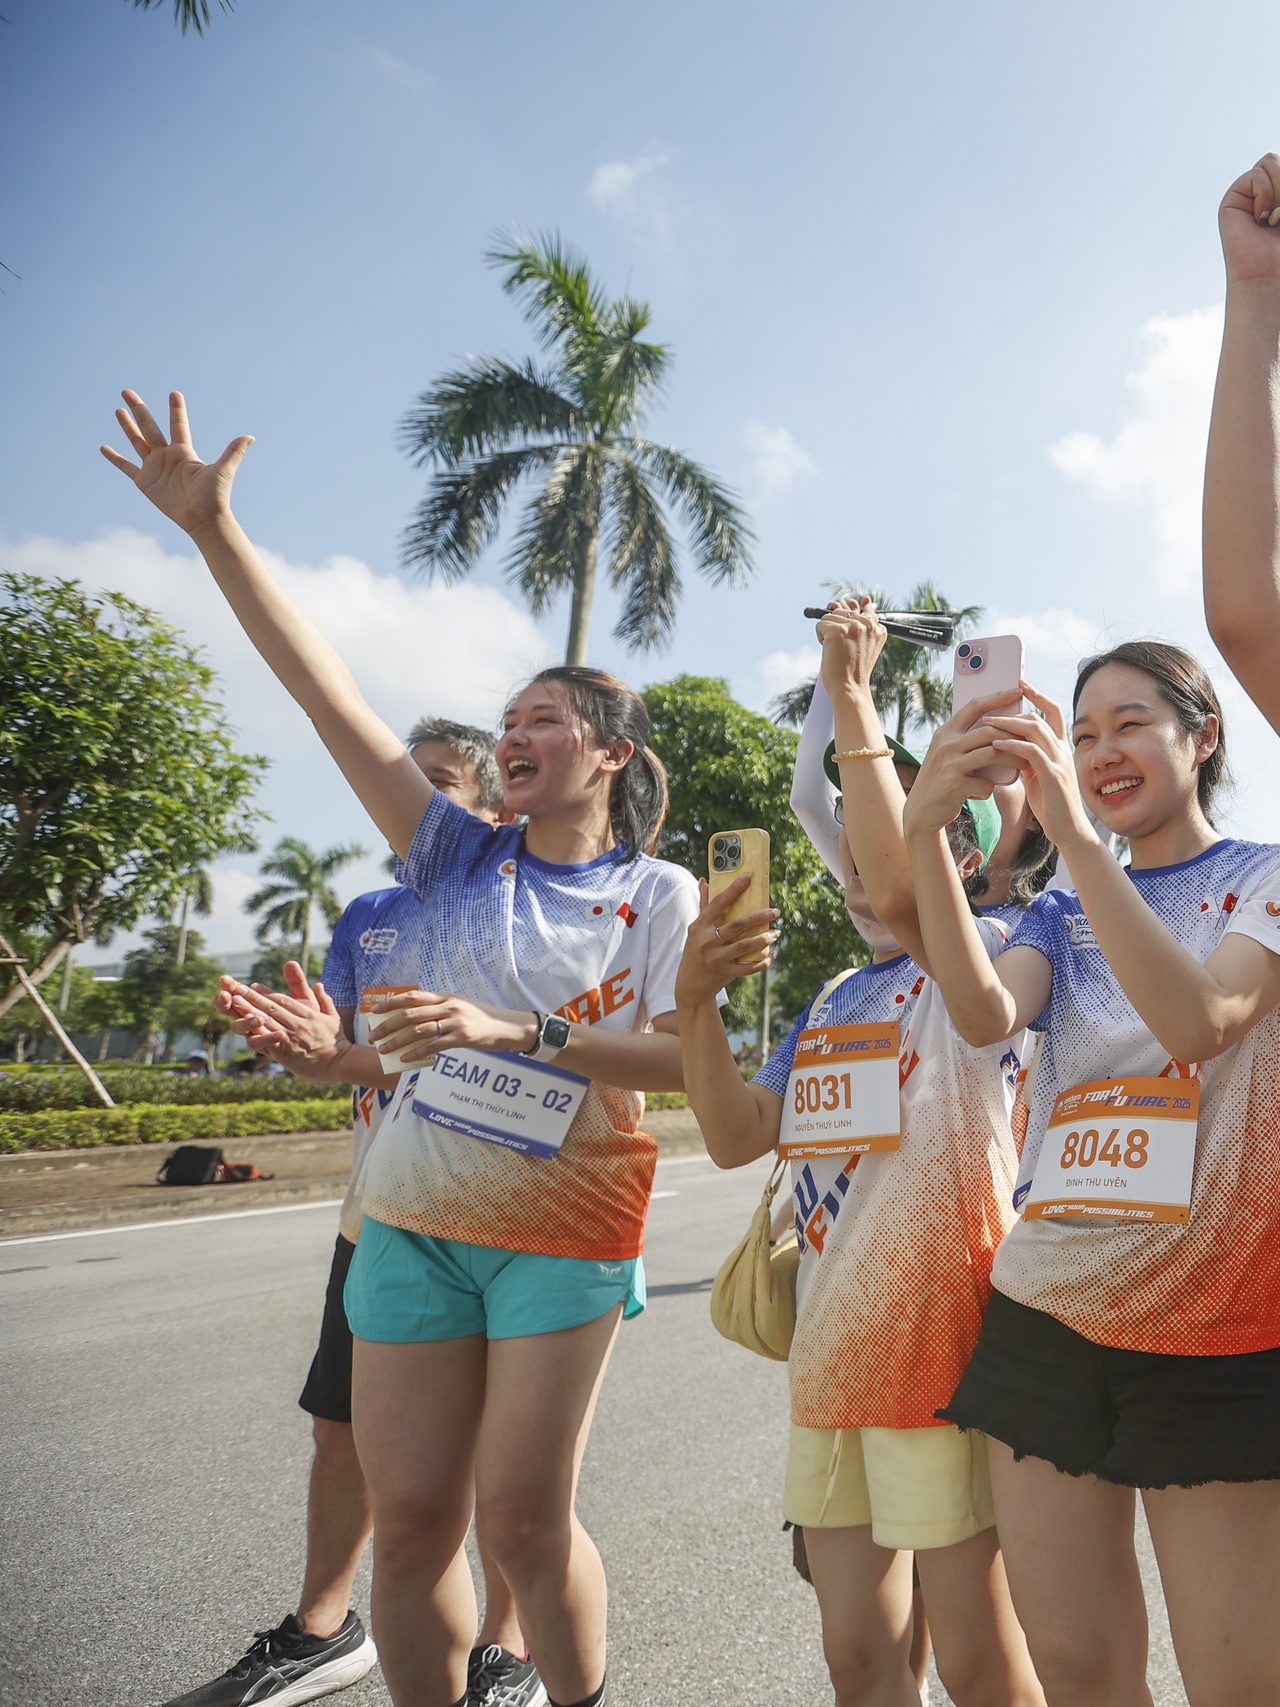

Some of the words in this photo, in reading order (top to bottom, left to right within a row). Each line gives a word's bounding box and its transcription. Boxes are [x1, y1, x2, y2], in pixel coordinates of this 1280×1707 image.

[874, 1038, 891, 1049] 2025
[431, 1052, 491, 1089] TEAM
[491, 1073, 522, 1098] 03
[541, 1088, 573, 1114] 02
[794, 1072, 852, 1115] 8031
[449, 1091, 472, 1103] PHẠM
[471, 1098, 485, 1110] THỊ
[506, 1109, 526, 1121] LINH
[1172, 1098, 1191, 1110] 2025
[428, 1111, 455, 1127] LOVE
[467, 1127, 529, 1151] POSSIBILITIES
[794, 1119, 815, 1132] NGUYỄN
[833, 1119, 852, 1129] LINH
[787, 1148, 805, 1157] LOVE
[814, 1143, 871, 1156] POSSIBILITIES
[1060, 1128, 1149, 1169] 8048
[1085, 1178, 1101, 1187] THU
[1103, 1176, 1128, 1188] UYÊN
[1041, 1204, 1067, 1215] LOVE
[1082, 1206, 1155, 1219] POSSIBILITIES
